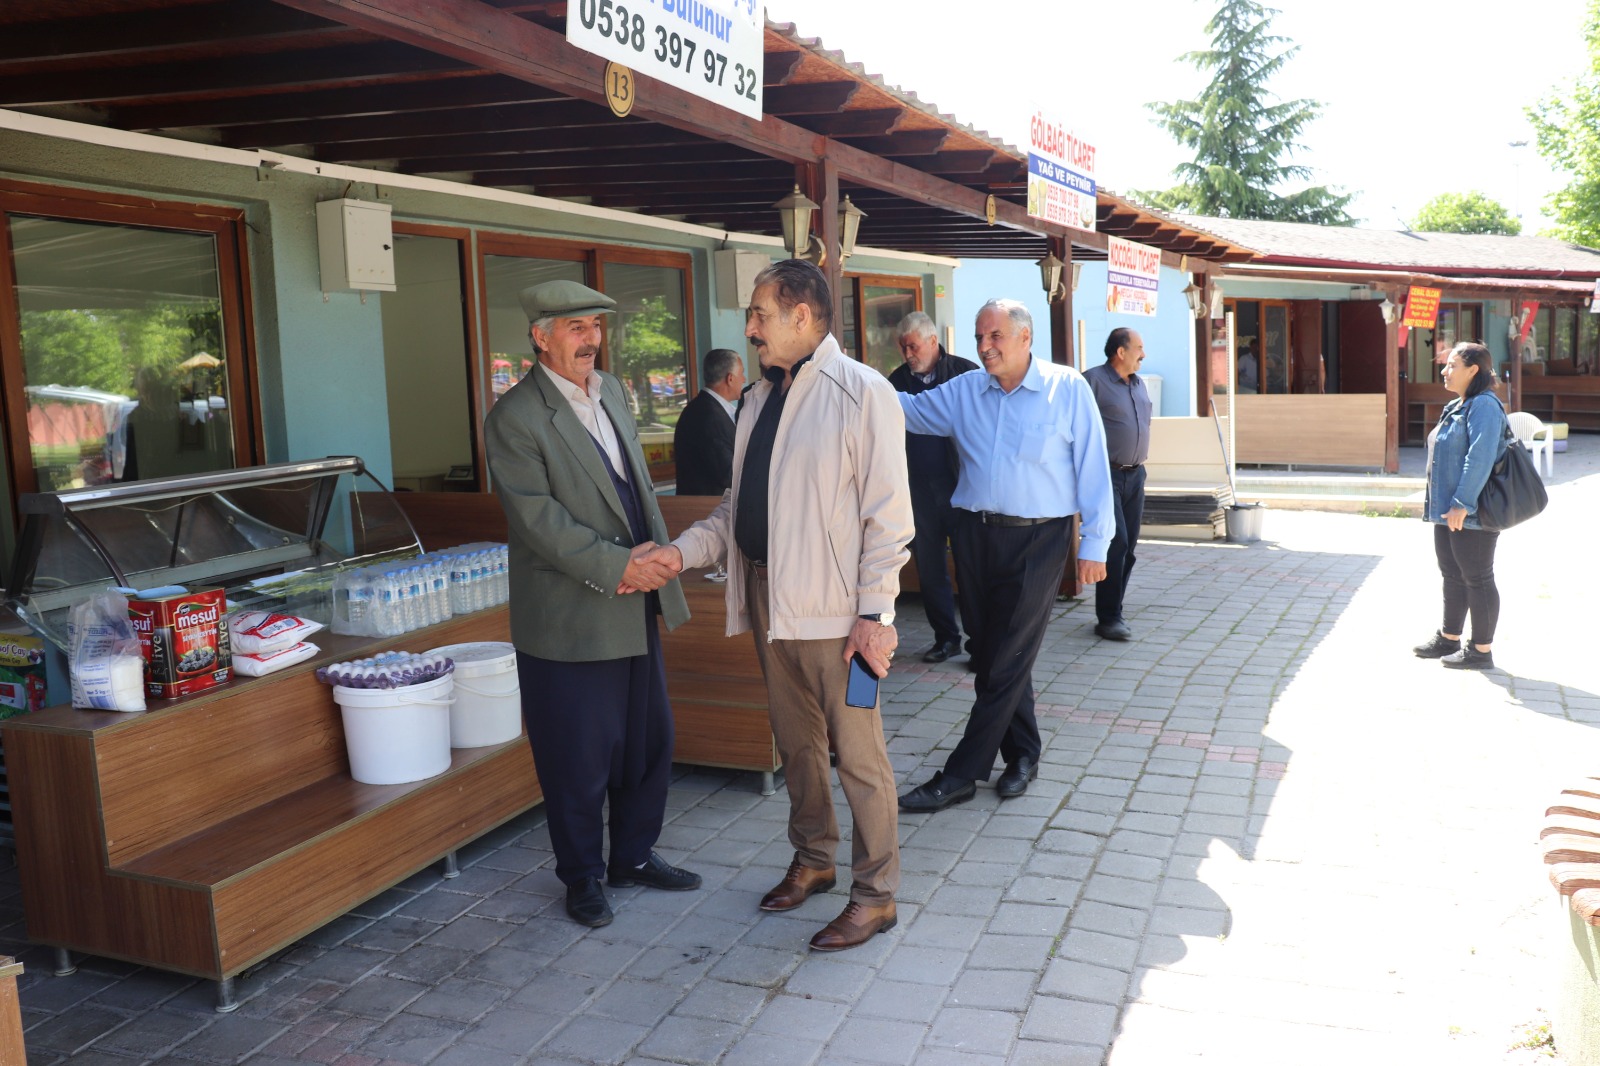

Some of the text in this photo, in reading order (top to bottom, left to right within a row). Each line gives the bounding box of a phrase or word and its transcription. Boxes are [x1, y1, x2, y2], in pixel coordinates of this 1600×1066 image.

[579, 0, 757, 101] 0538 397 97 32
[612, 71, 629, 101] 13
[1030, 110, 1096, 174] GÖLBAĞI TİCARET
[1037, 160, 1092, 192] YAĞ VE PEYNİR
[131, 617, 151, 631] sut
[178, 606, 217, 628] mesut
